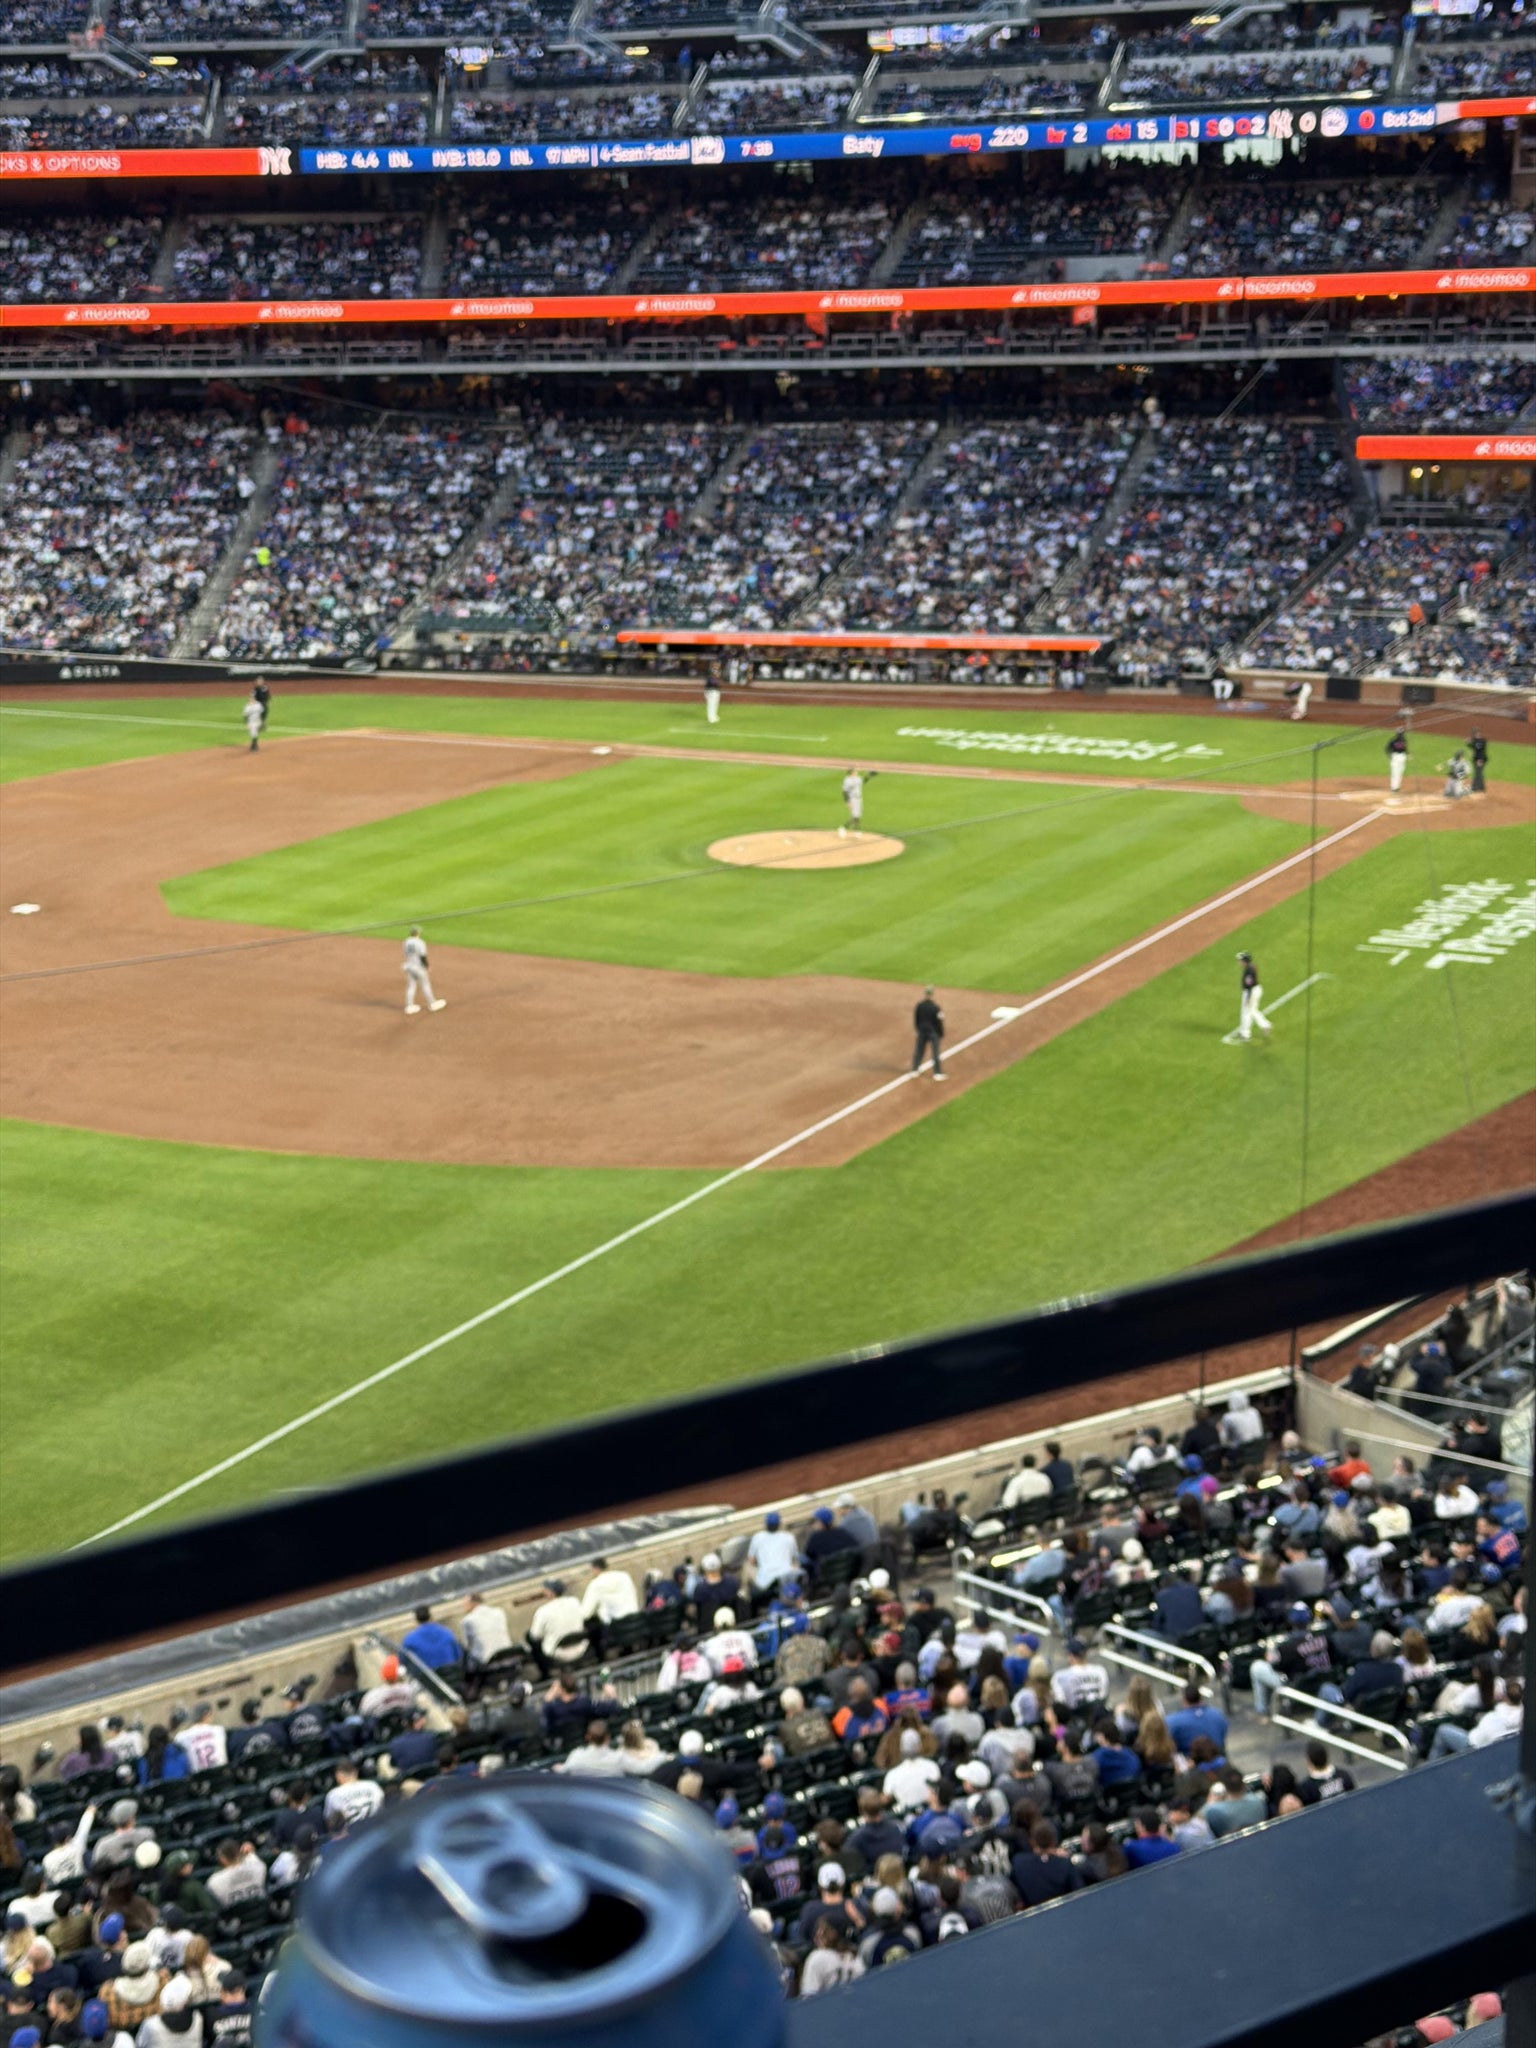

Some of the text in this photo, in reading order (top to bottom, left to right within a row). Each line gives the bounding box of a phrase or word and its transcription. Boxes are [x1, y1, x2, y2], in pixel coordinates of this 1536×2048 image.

[950, 133, 982, 152] avg
[989, 125, 1029, 146] .220
[1073, 122, 1088, 143] 2
[1137, 119, 1158, 140] 15
[843, 134, 884, 157] Baty
[46, 156, 121, 171] OPTIONS
[73, 666, 120, 678] DELTA
